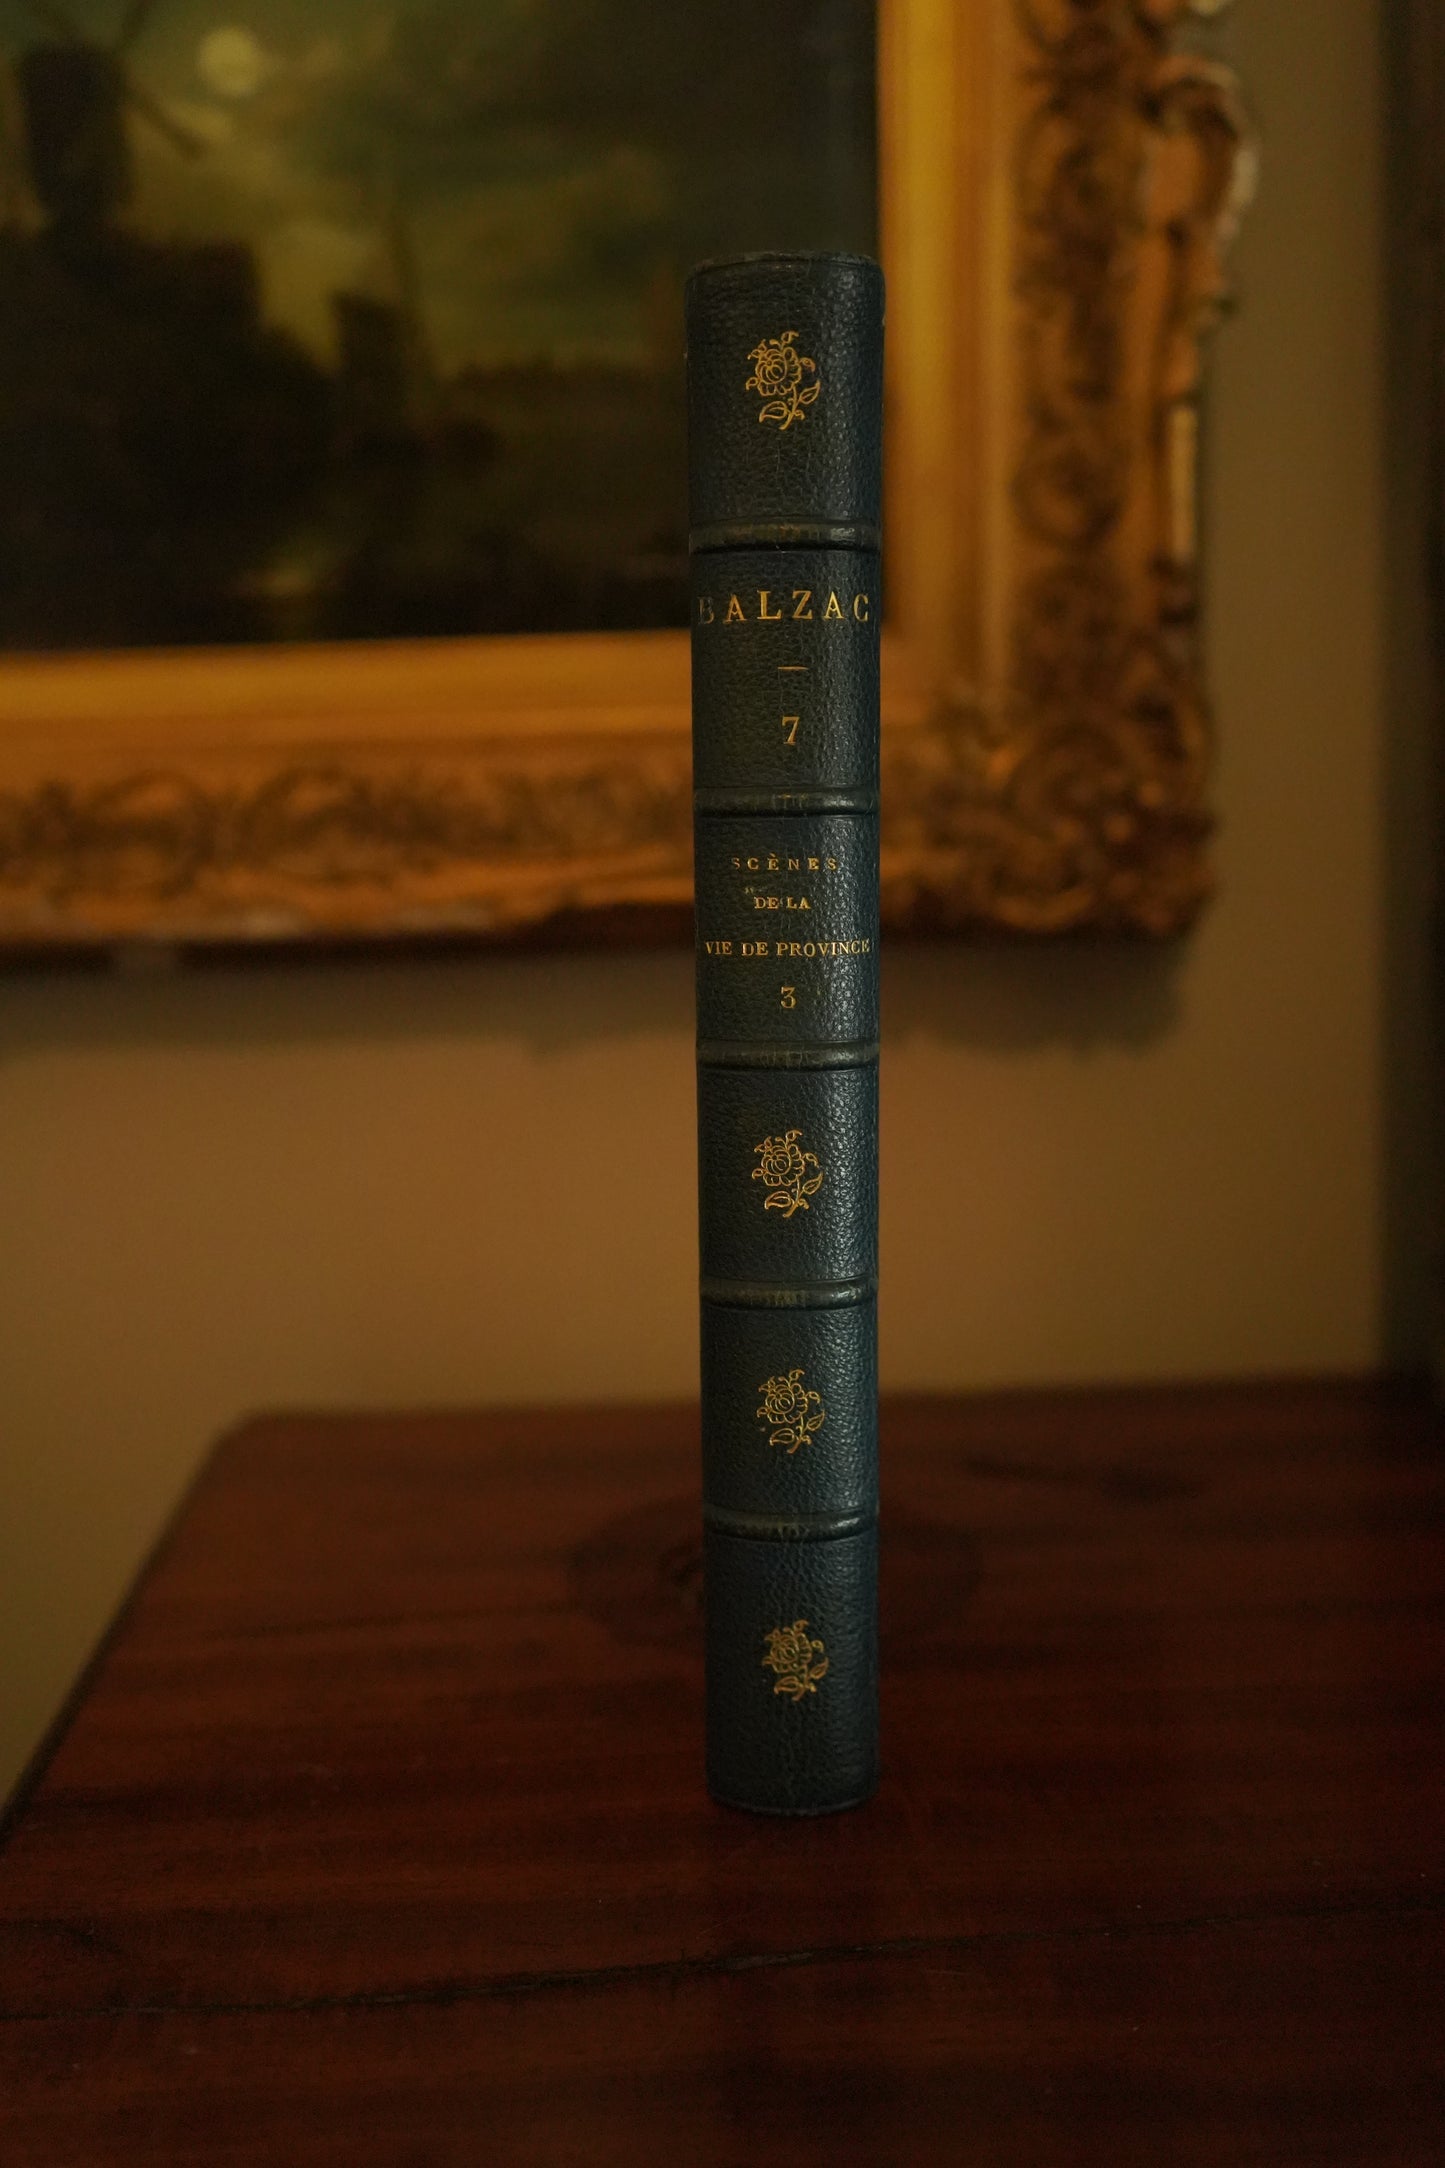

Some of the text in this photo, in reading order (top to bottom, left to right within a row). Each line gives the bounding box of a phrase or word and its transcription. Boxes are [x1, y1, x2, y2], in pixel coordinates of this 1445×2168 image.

[698, 590, 869, 624] BALZAC
[782, 716, 800, 745] 7
[732, 853, 838, 871] SCÈNES
[754, 897, 811, 909] DE LA
[705, 938, 870, 957] VIE DE PROVINCE
[780, 986, 797, 1008] 3
